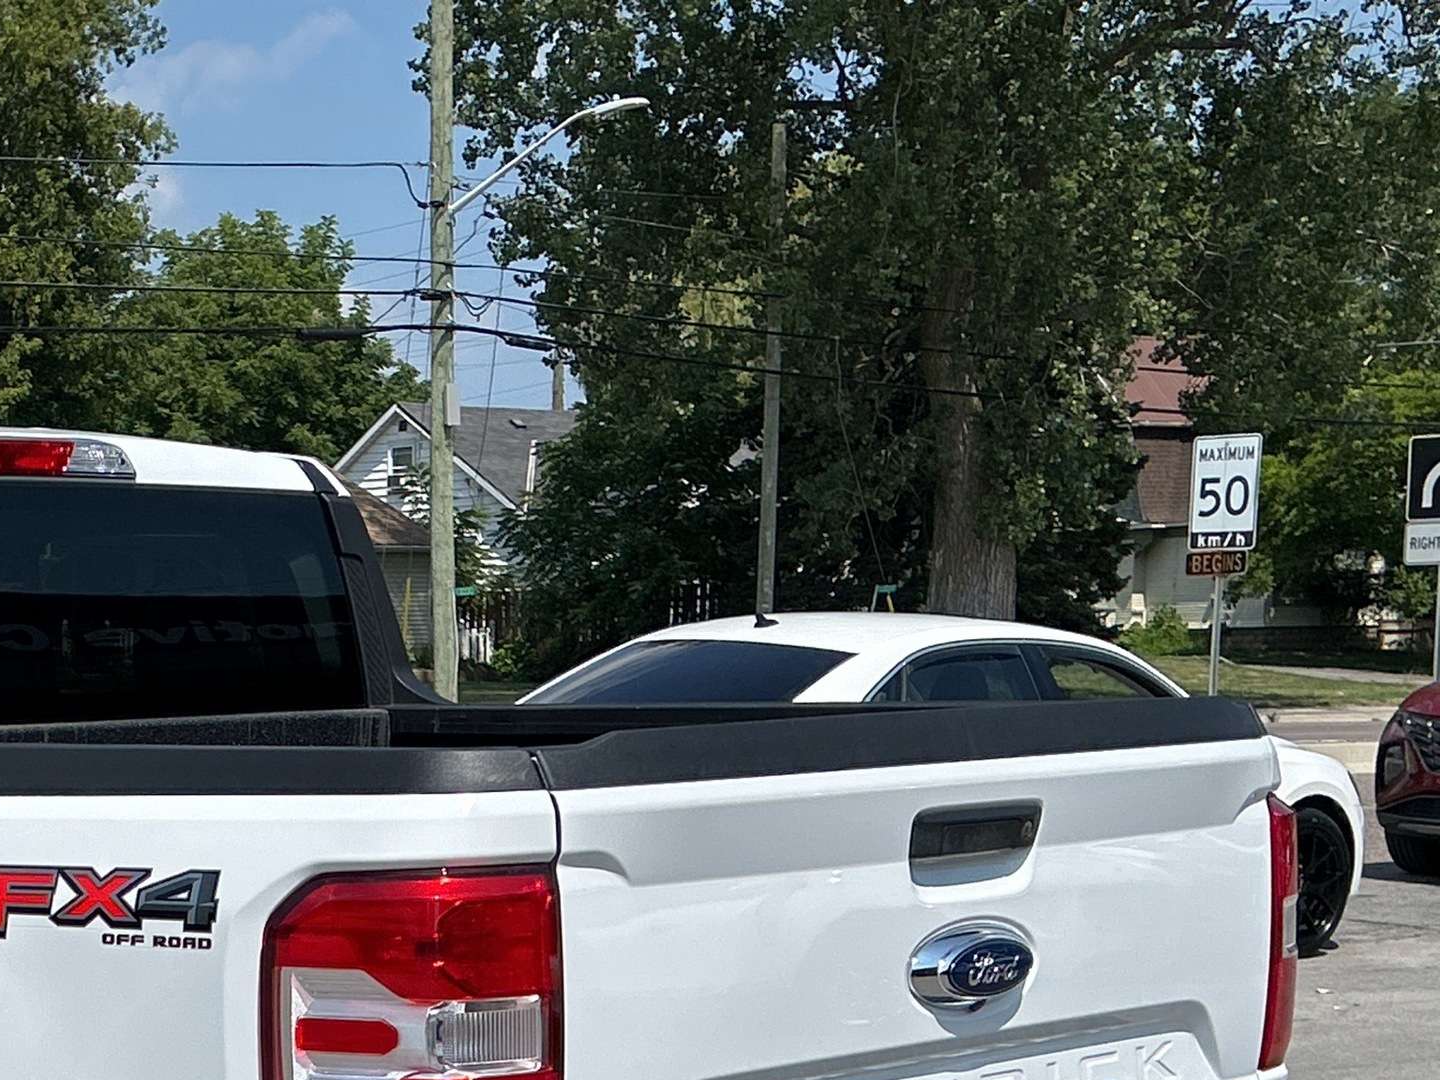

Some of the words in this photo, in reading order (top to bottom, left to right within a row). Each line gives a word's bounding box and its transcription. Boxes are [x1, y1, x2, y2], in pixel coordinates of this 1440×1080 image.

[1199, 446, 1255, 462] MAXIMUM
[1198, 475, 1250, 518] 50
[1197, 533, 1247, 548] km/h
[1192, 554, 1243, 573] BEGINS
[101, 932, 145, 946] OFF
[152, 935, 212, 950] ROAD
[968, 951, 1020, 987] Ford
